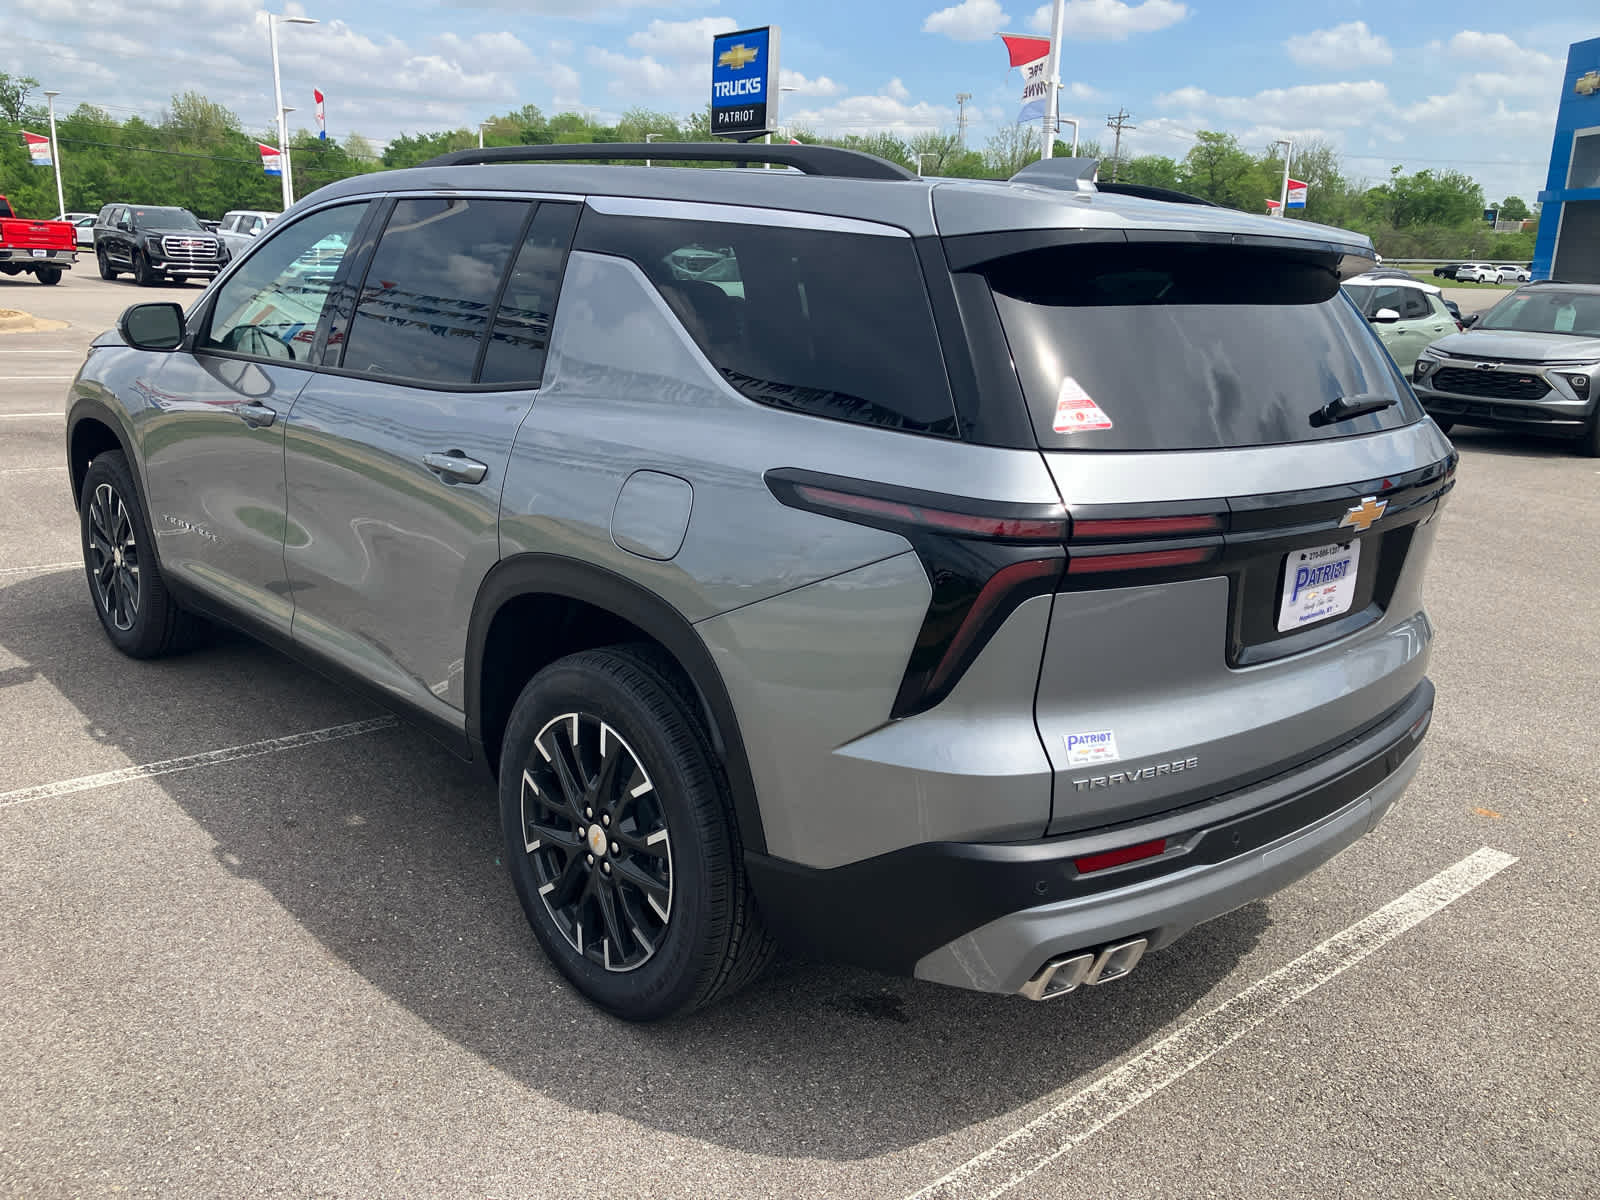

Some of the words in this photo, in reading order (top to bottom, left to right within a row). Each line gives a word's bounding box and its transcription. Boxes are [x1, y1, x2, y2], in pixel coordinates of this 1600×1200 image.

[714, 77, 761, 97] TRUCKS
[719, 110, 754, 123] PATRIOT
[1292, 560, 1350, 602] PATRIOT
[1067, 732, 1112, 751] PATRIOT
[1072, 756, 1199, 793] TRAVERSE
